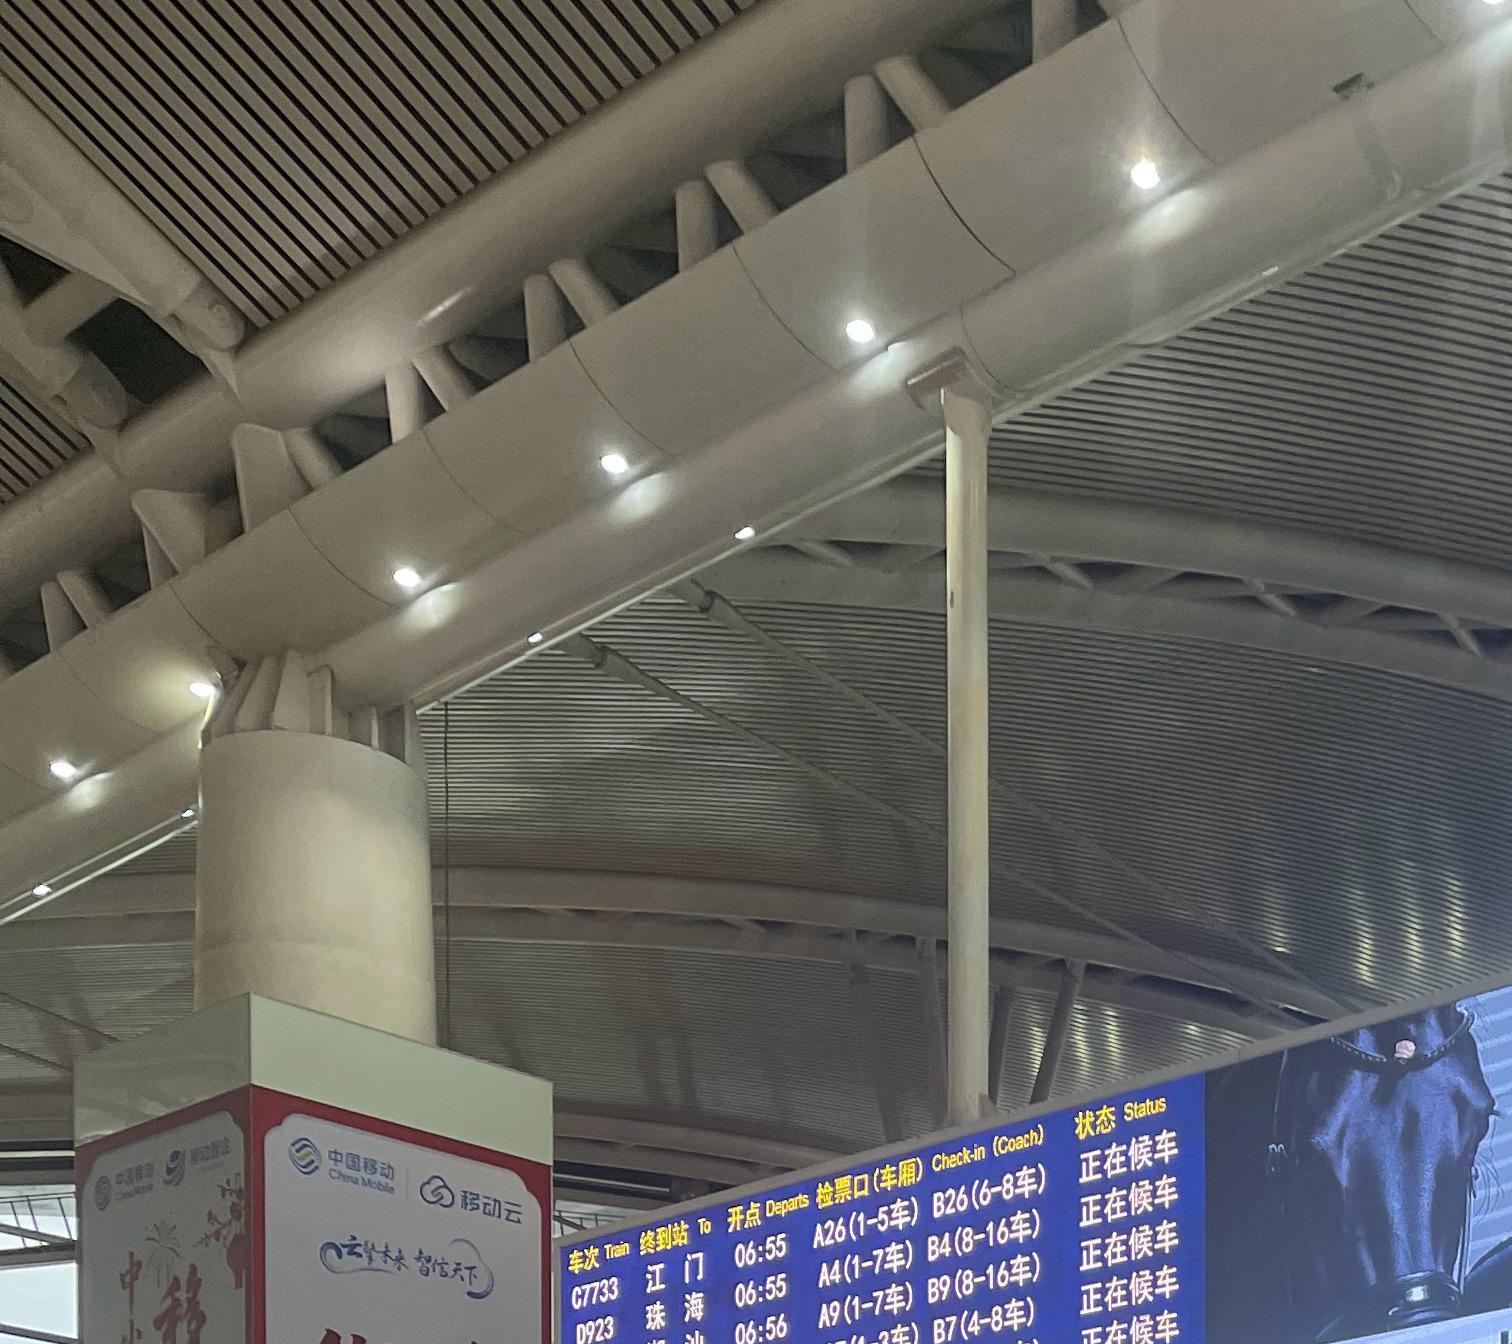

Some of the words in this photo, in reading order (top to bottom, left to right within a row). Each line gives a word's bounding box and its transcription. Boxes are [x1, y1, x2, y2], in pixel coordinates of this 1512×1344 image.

[328, 1149, 395, 1182] 中国移动
[328, 1168, 360, 1186] China
[360, 1174, 396, 1195] Mobile
[567, 1245, 600, 1275] 车次
[603, 1240, 631, 1260] Train
[639, 1220, 690, 1256] 终到站
[697, 1217, 712, 1235] To
[727, 1201, 762, 1233] 开点
[765, 1193, 810, 1218] Departs
[931, 1143, 986, 1172] Check-in
[992, 1123, 1044, 1157] (Coach)
[1073, 1104, 1116, 1141] 状态
[1123, 1097, 1167, 1122] Status
[460, 1189, 523, 1224] 移动云
[571, 1276, 619, 1310] C7733
[734, 1232, 787, 1268] 06:55
[1078, 1128, 1179, 1184] 正在候车
[734, 1272, 787, 1308] 06:55
[1079, 1173, 1179, 1228] 正在候车
[1079, 1219, 1179, 1272] 正在候车
[1079, 1264, 1180, 1315] 正在候车
